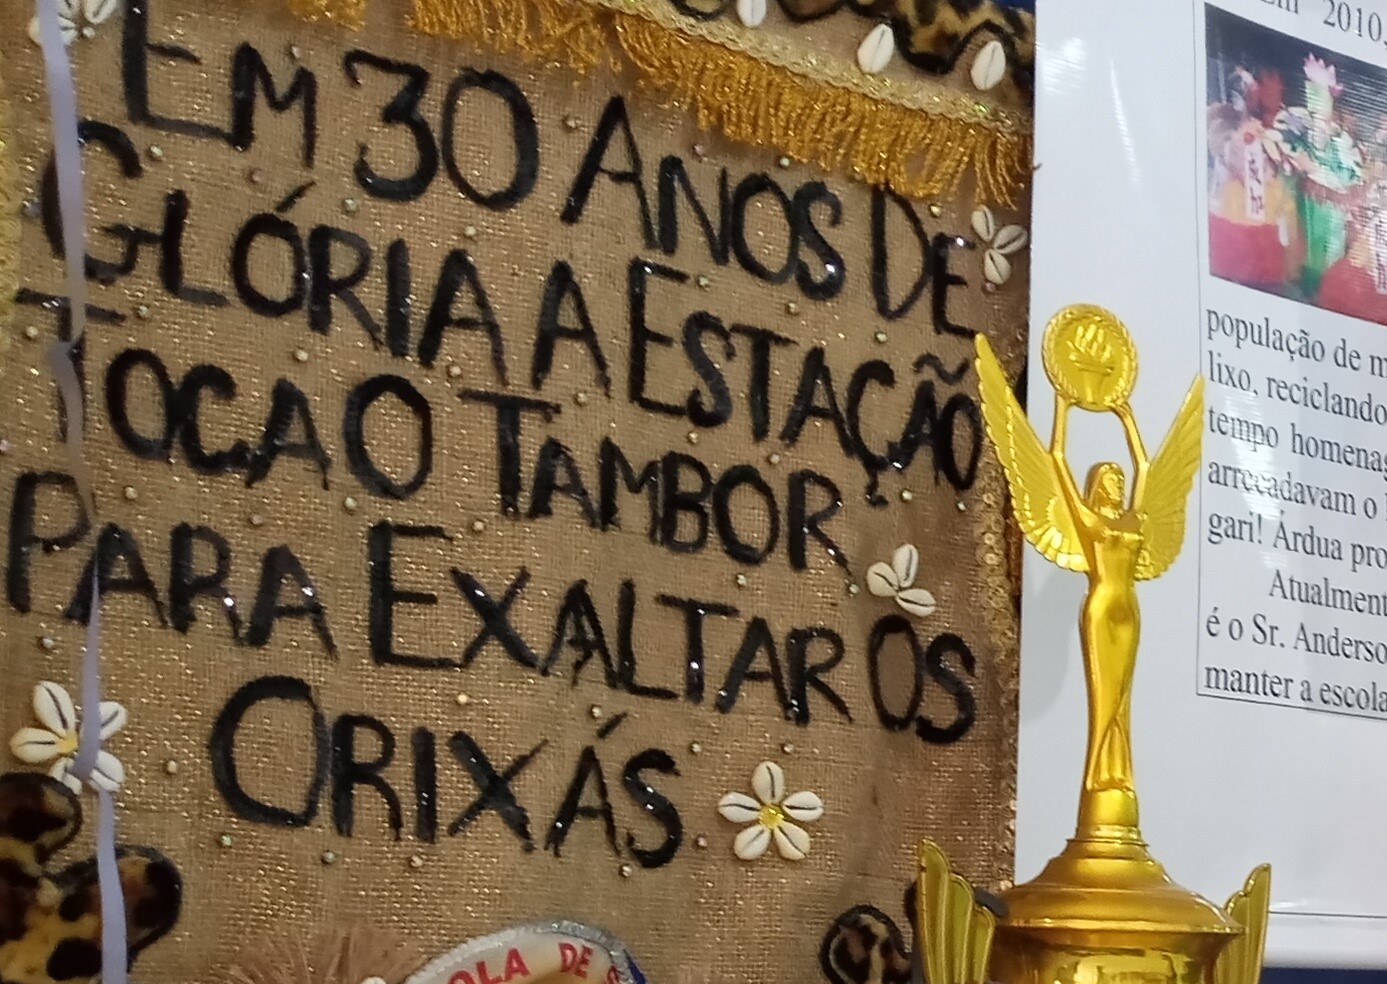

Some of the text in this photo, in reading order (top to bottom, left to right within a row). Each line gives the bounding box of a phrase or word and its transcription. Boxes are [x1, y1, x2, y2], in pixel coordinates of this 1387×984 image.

[344, 51, 538, 209] 30
[562, 97, 845, 297] ANOS
[870, 185, 976, 337] DE
[1206, 309, 1325, 362] população
[1334, 338, 1362, 371] de
[532, 261, 611, 398] A
[630, 256, 981, 505] ESTAÇÃO
[1208, 350, 1258, 397] lixo,
[1208, 405, 1279, 452] tempo
[457, 387, 853, 575] TAMBOR
[1208, 459, 1356, 516] arrecadavam
[1207, 511, 1264, 546] gari!
[1273, 510, 1343, 561] Árdua
[4, 472, 976, 742] PARA EXALTAR OS
[1206, 606, 1221, 638] é
[1228, 617, 1244, 642] o
[1252, 613, 1284, 649] Sr.
[1204, 665, 1294, 701] manter
[212, 677, 682, 868] ORIXÁS
[559, 942, 593, 978] DE
